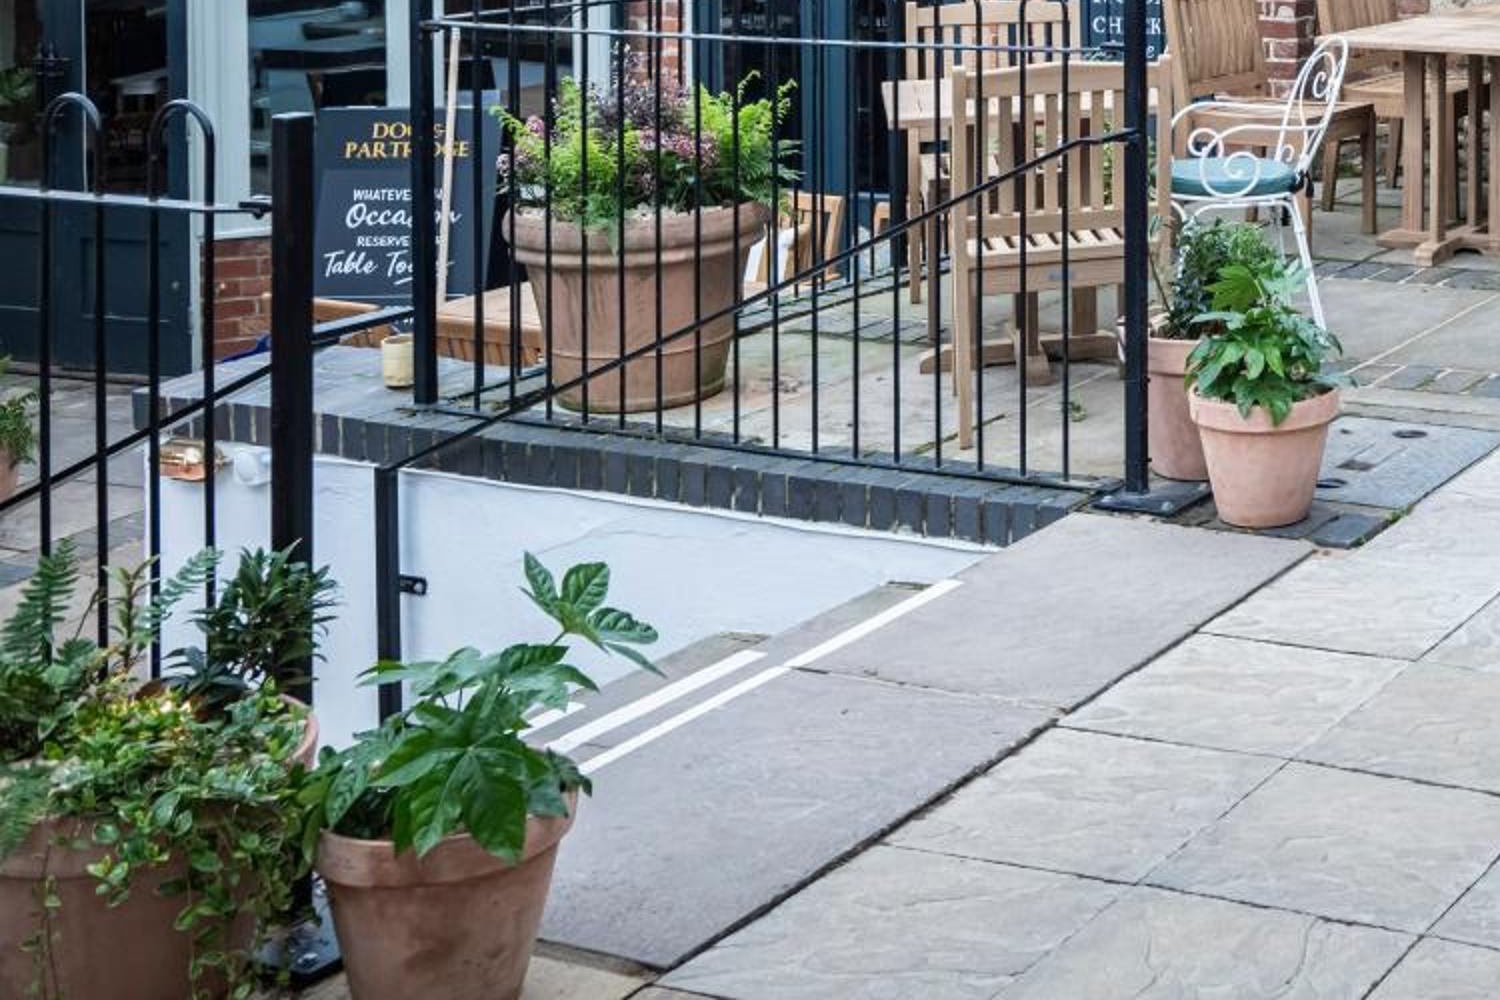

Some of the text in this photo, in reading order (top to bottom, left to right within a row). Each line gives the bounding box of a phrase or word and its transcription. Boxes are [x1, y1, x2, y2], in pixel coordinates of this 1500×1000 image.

[1092, 16, 1161, 35] CHK
[371, 121, 412, 139] DO
[353, 188, 412, 202] WHATEVE
[323, 250, 378, 278] Table
